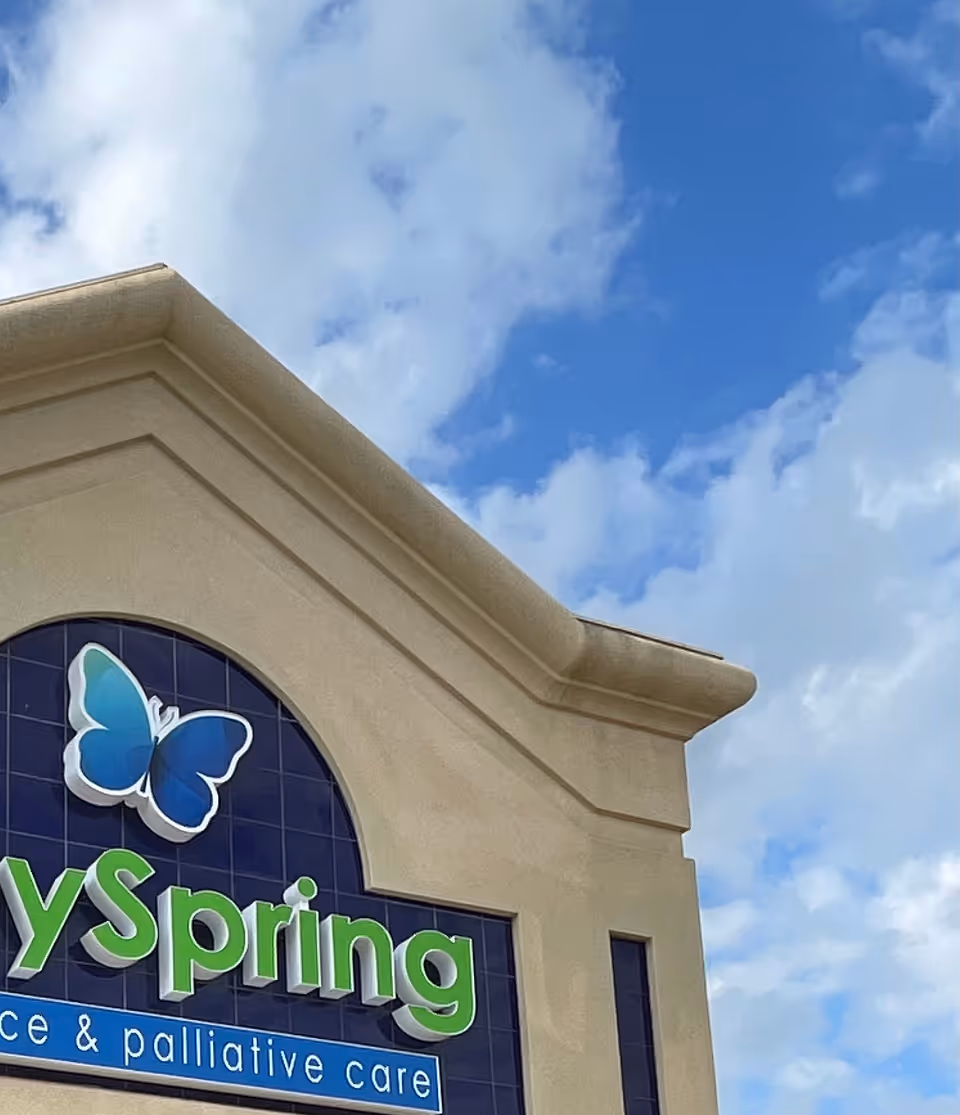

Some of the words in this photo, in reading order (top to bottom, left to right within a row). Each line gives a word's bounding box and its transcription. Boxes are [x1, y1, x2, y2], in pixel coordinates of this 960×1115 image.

[75, 1013, 99, 1053] &
[124, 1026, 324, 1083] palliative
[346, 1060, 431, 1098] care
